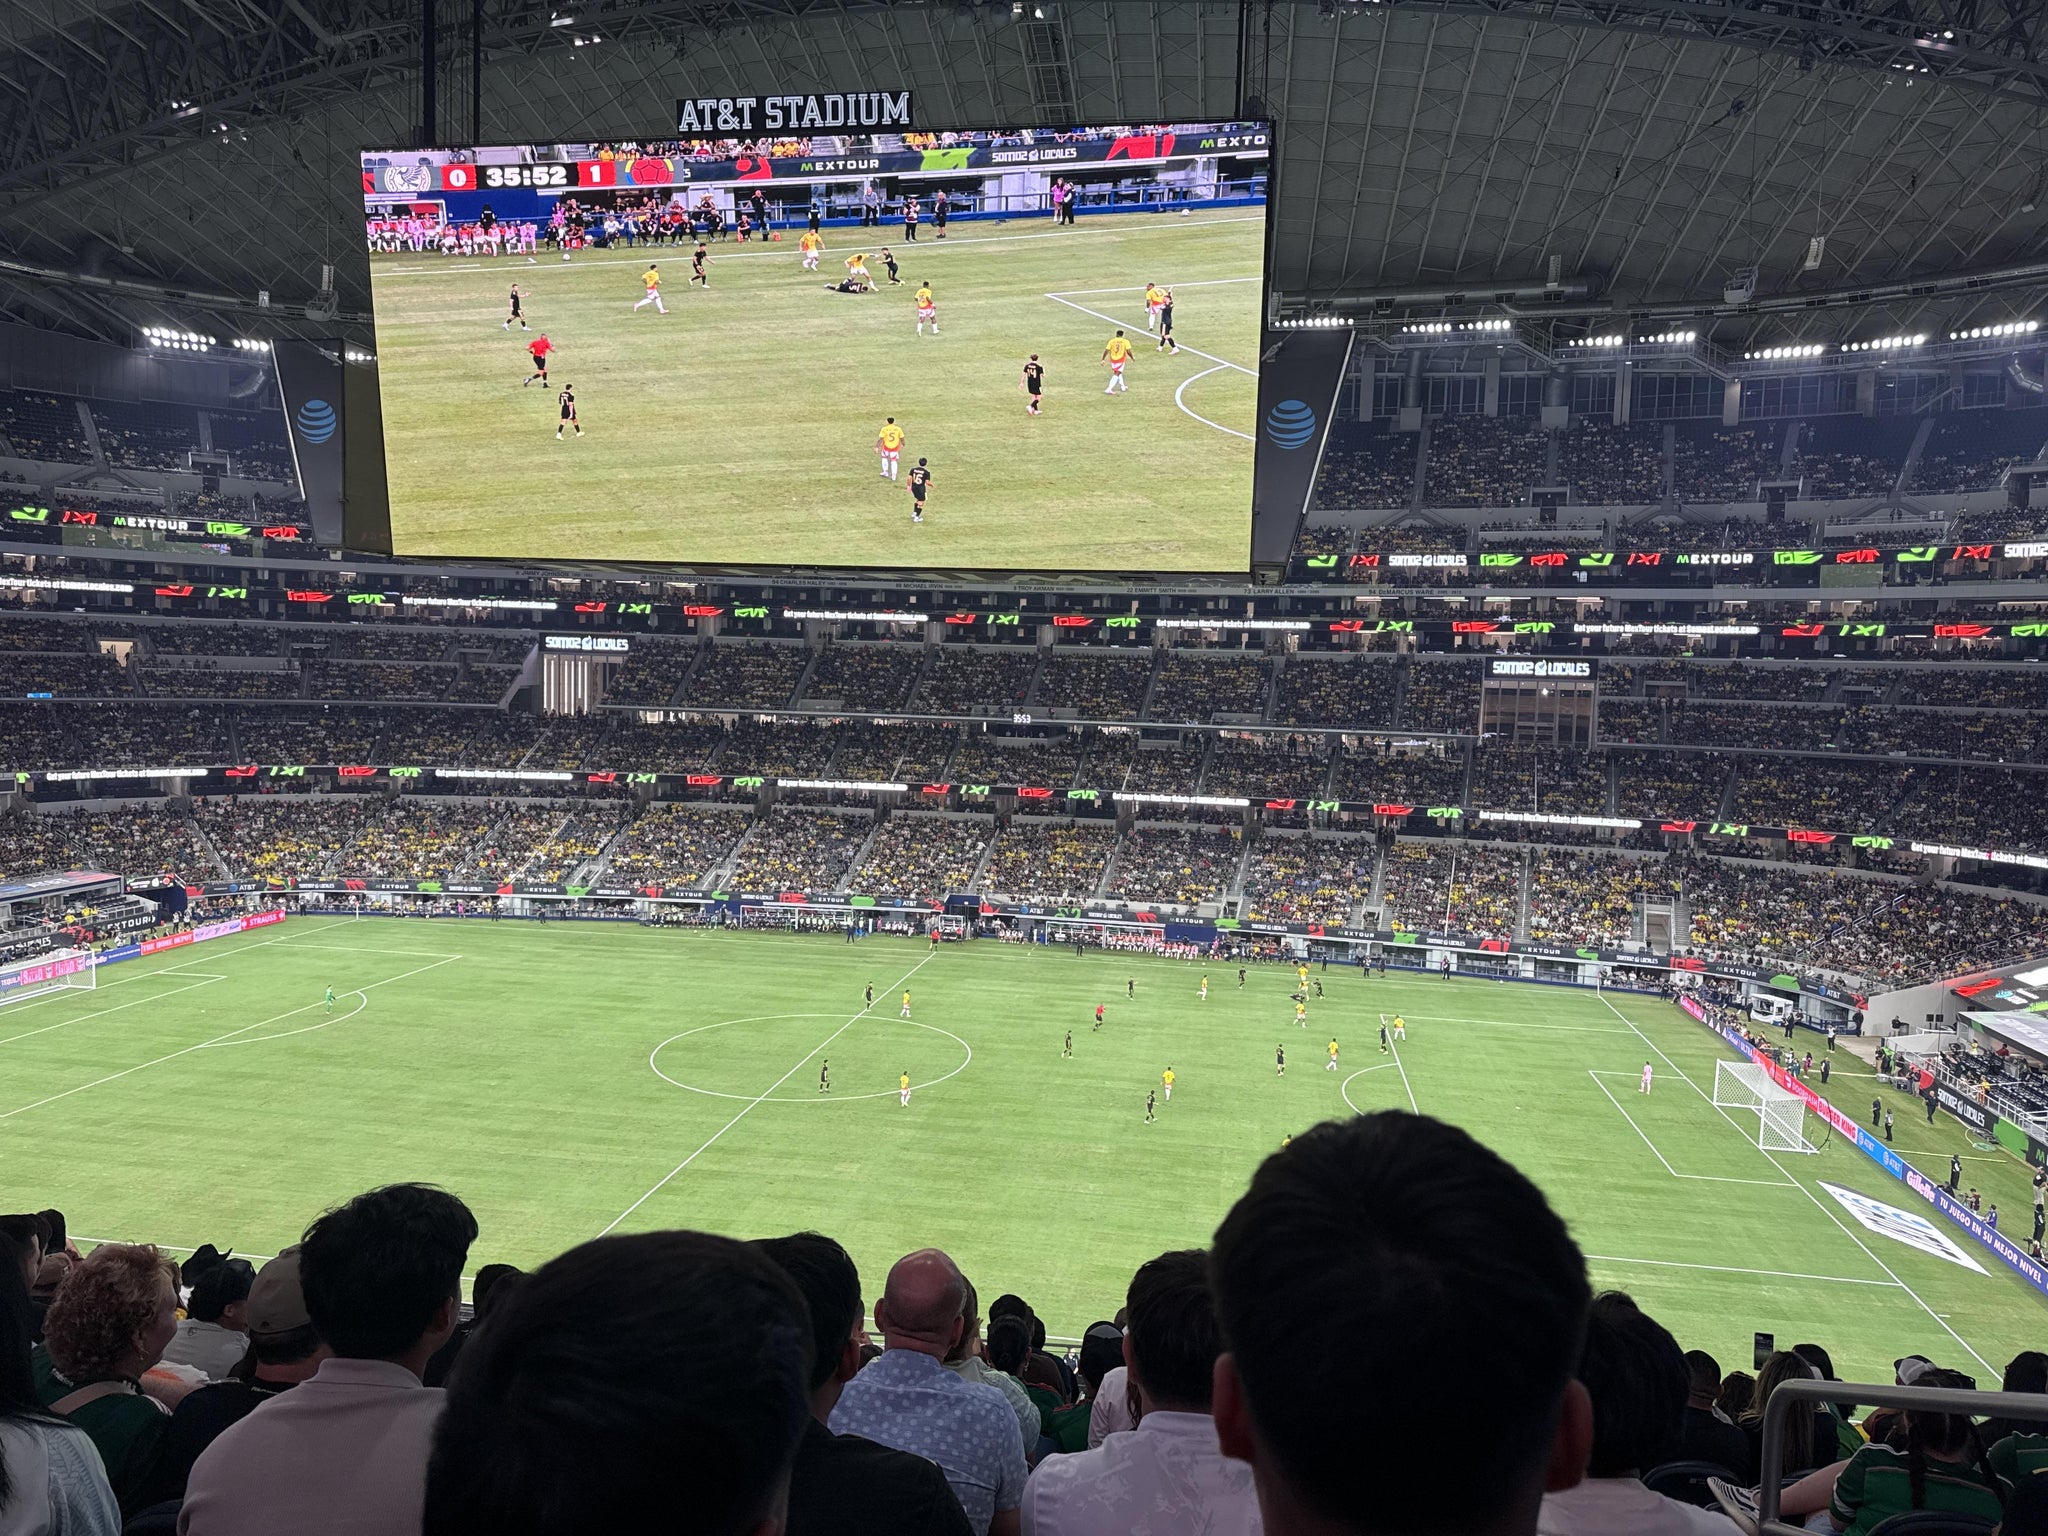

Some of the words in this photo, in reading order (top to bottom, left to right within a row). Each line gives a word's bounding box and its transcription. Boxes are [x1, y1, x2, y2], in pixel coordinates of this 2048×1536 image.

[679, 98, 756, 131] AT&T
[765, 92, 910, 129] STADIUM
[1040, 148, 1077, 160] LOCALES
[800, 159, 879, 171] MEXTOUR
[450, 170, 467, 187] 0
[486, 166, 567, 187] 35:52
[589, 165, 601, 182] 1
[888, 432, 895, 442] 5
[113, 516, 188, 530] MEXTOUR
[1432, 554, 1467, 566] LOCALES
[1676, 553, 1753, 565] MEXTOUR
[1574, 624, 1586, 633] Get
[1586, 625, 1601, 635] your
[1602, 624, 1624, 633] future
[1654, 625, 1678, 634] tickets
[1679, 625, 1686, 634] at
[593, 637, 629, 650] LOCALES
[1547, 662, 1590, 676] LOCALES
[249, 914, 277, 926] STRAUSS
[1337, 930, 1374, 938] MEXTOUR
[1520, 946, 1561, 955] MEXTOUR
[1715, 966, 1757, 977] MEXTOUR
[1826, 989, 1840, 999] AT&T
[1841, 1119, 1856, 1139] KING
[1864, 1138, 1875, 1152] AT&T
[1889, 1158, 1901, 1172] AT&T
[1906, 1171, 1936, 1203] Gillette
[1939, 1197, 1948, 1210] TU
[1949, 1204, 1971, 1227] JUEGO
[1971, 1222, 1982, 1236] EN
[1983, 1232, 1993, 1244] SU
[1994, 1239, 2018, 1264] MEJOR
[2019, 1259, 2042, 1284] NIVEL
